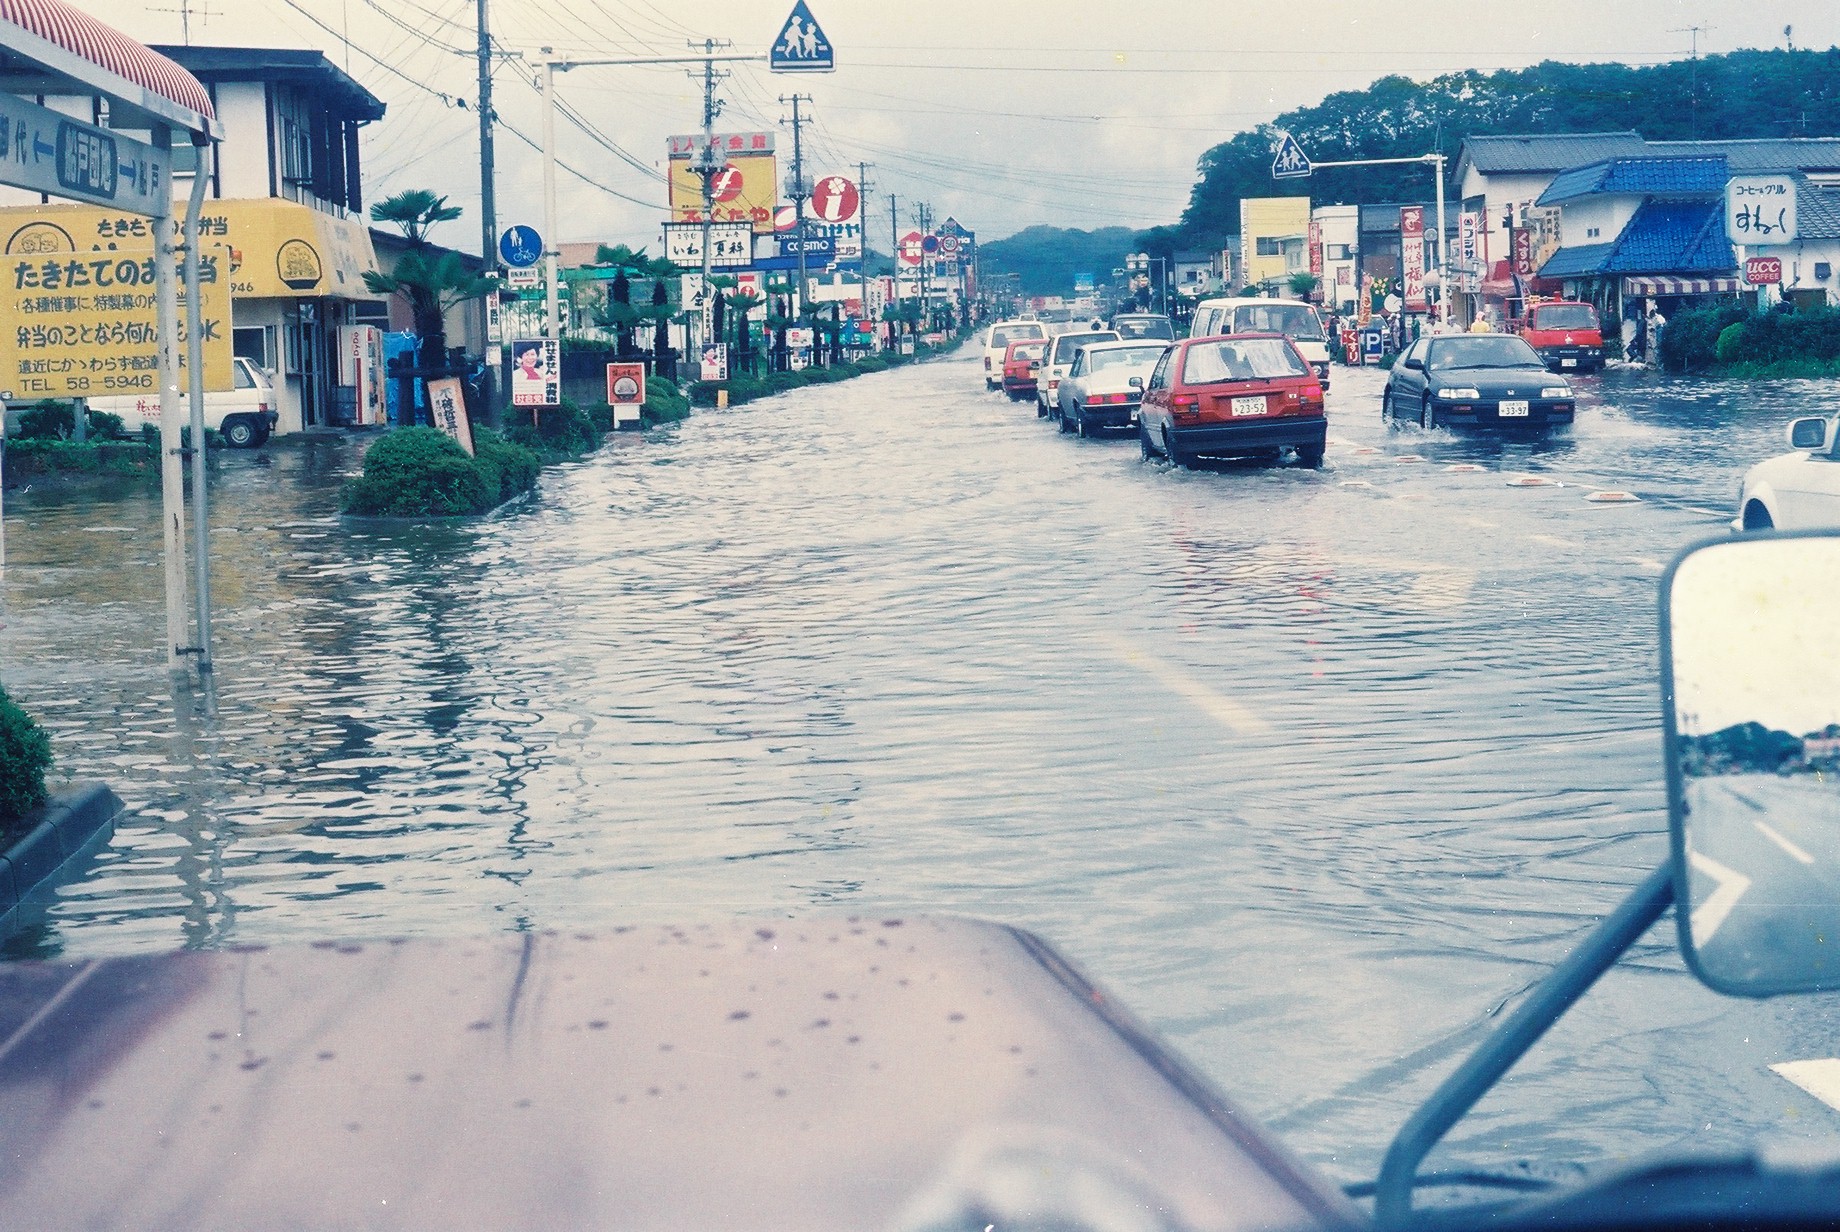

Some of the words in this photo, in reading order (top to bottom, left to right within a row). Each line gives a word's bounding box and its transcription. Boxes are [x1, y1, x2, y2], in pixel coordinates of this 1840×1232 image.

[1519, 232, 1529, 273] くすり
[1746, 261, 1780, 274] UCC
[1749, 273, 1780, 281] COFFEE
[17, 319, 221, 348] 弁当のことなら何んもK
[1347, 332, 1359, 362] くすり
[1366, 333, 1380, 351] P
[20, 378, 56, 391] TEL
[67, 375, 153, 390] 58-5946
[1240, 403, 1265, 415] 23-52
[1506, 406, 1527, 415] 33-97
